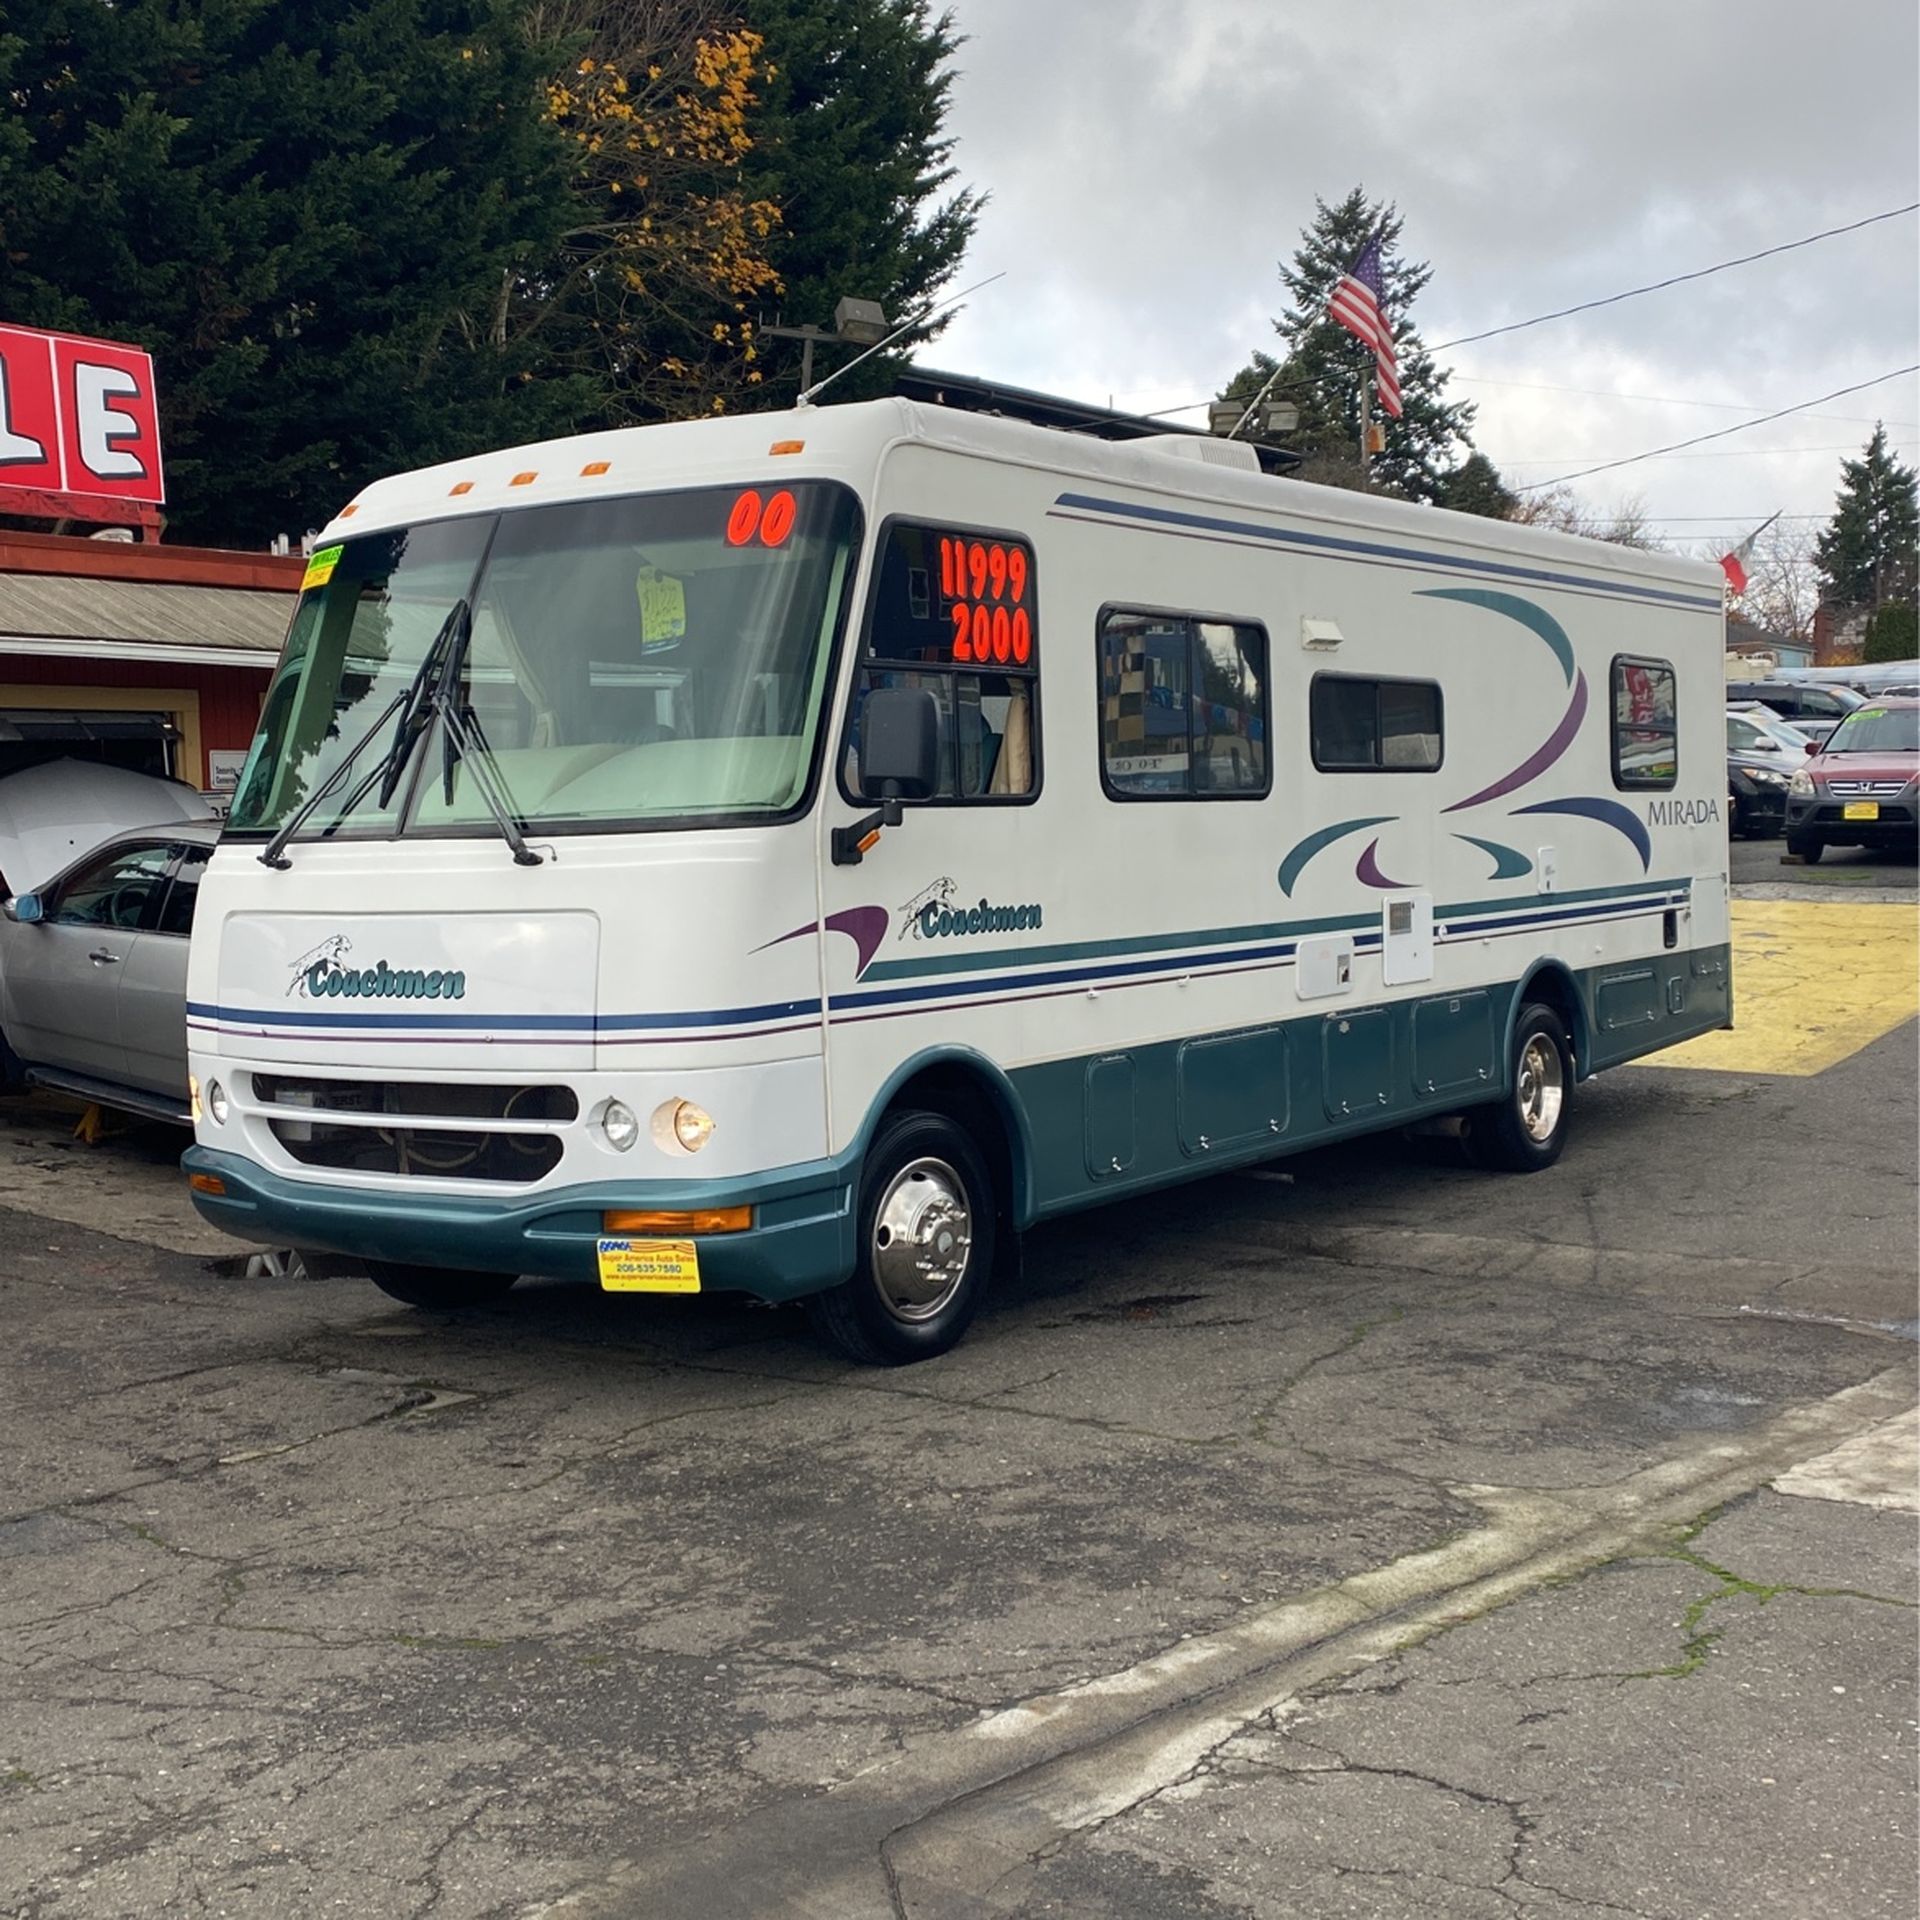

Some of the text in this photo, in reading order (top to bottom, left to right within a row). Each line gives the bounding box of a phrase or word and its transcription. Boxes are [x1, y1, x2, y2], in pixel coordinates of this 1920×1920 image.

[727, 490, 797, 547] 00
[941, 538, 1027, 603] 11999
[952, 602, 1030, 663] 2000
[1648, 798, 1719, 827] MIRADA
[918, 898, 1042, 938] Coachmen
[306, 958, 466, 999] Coachmen
